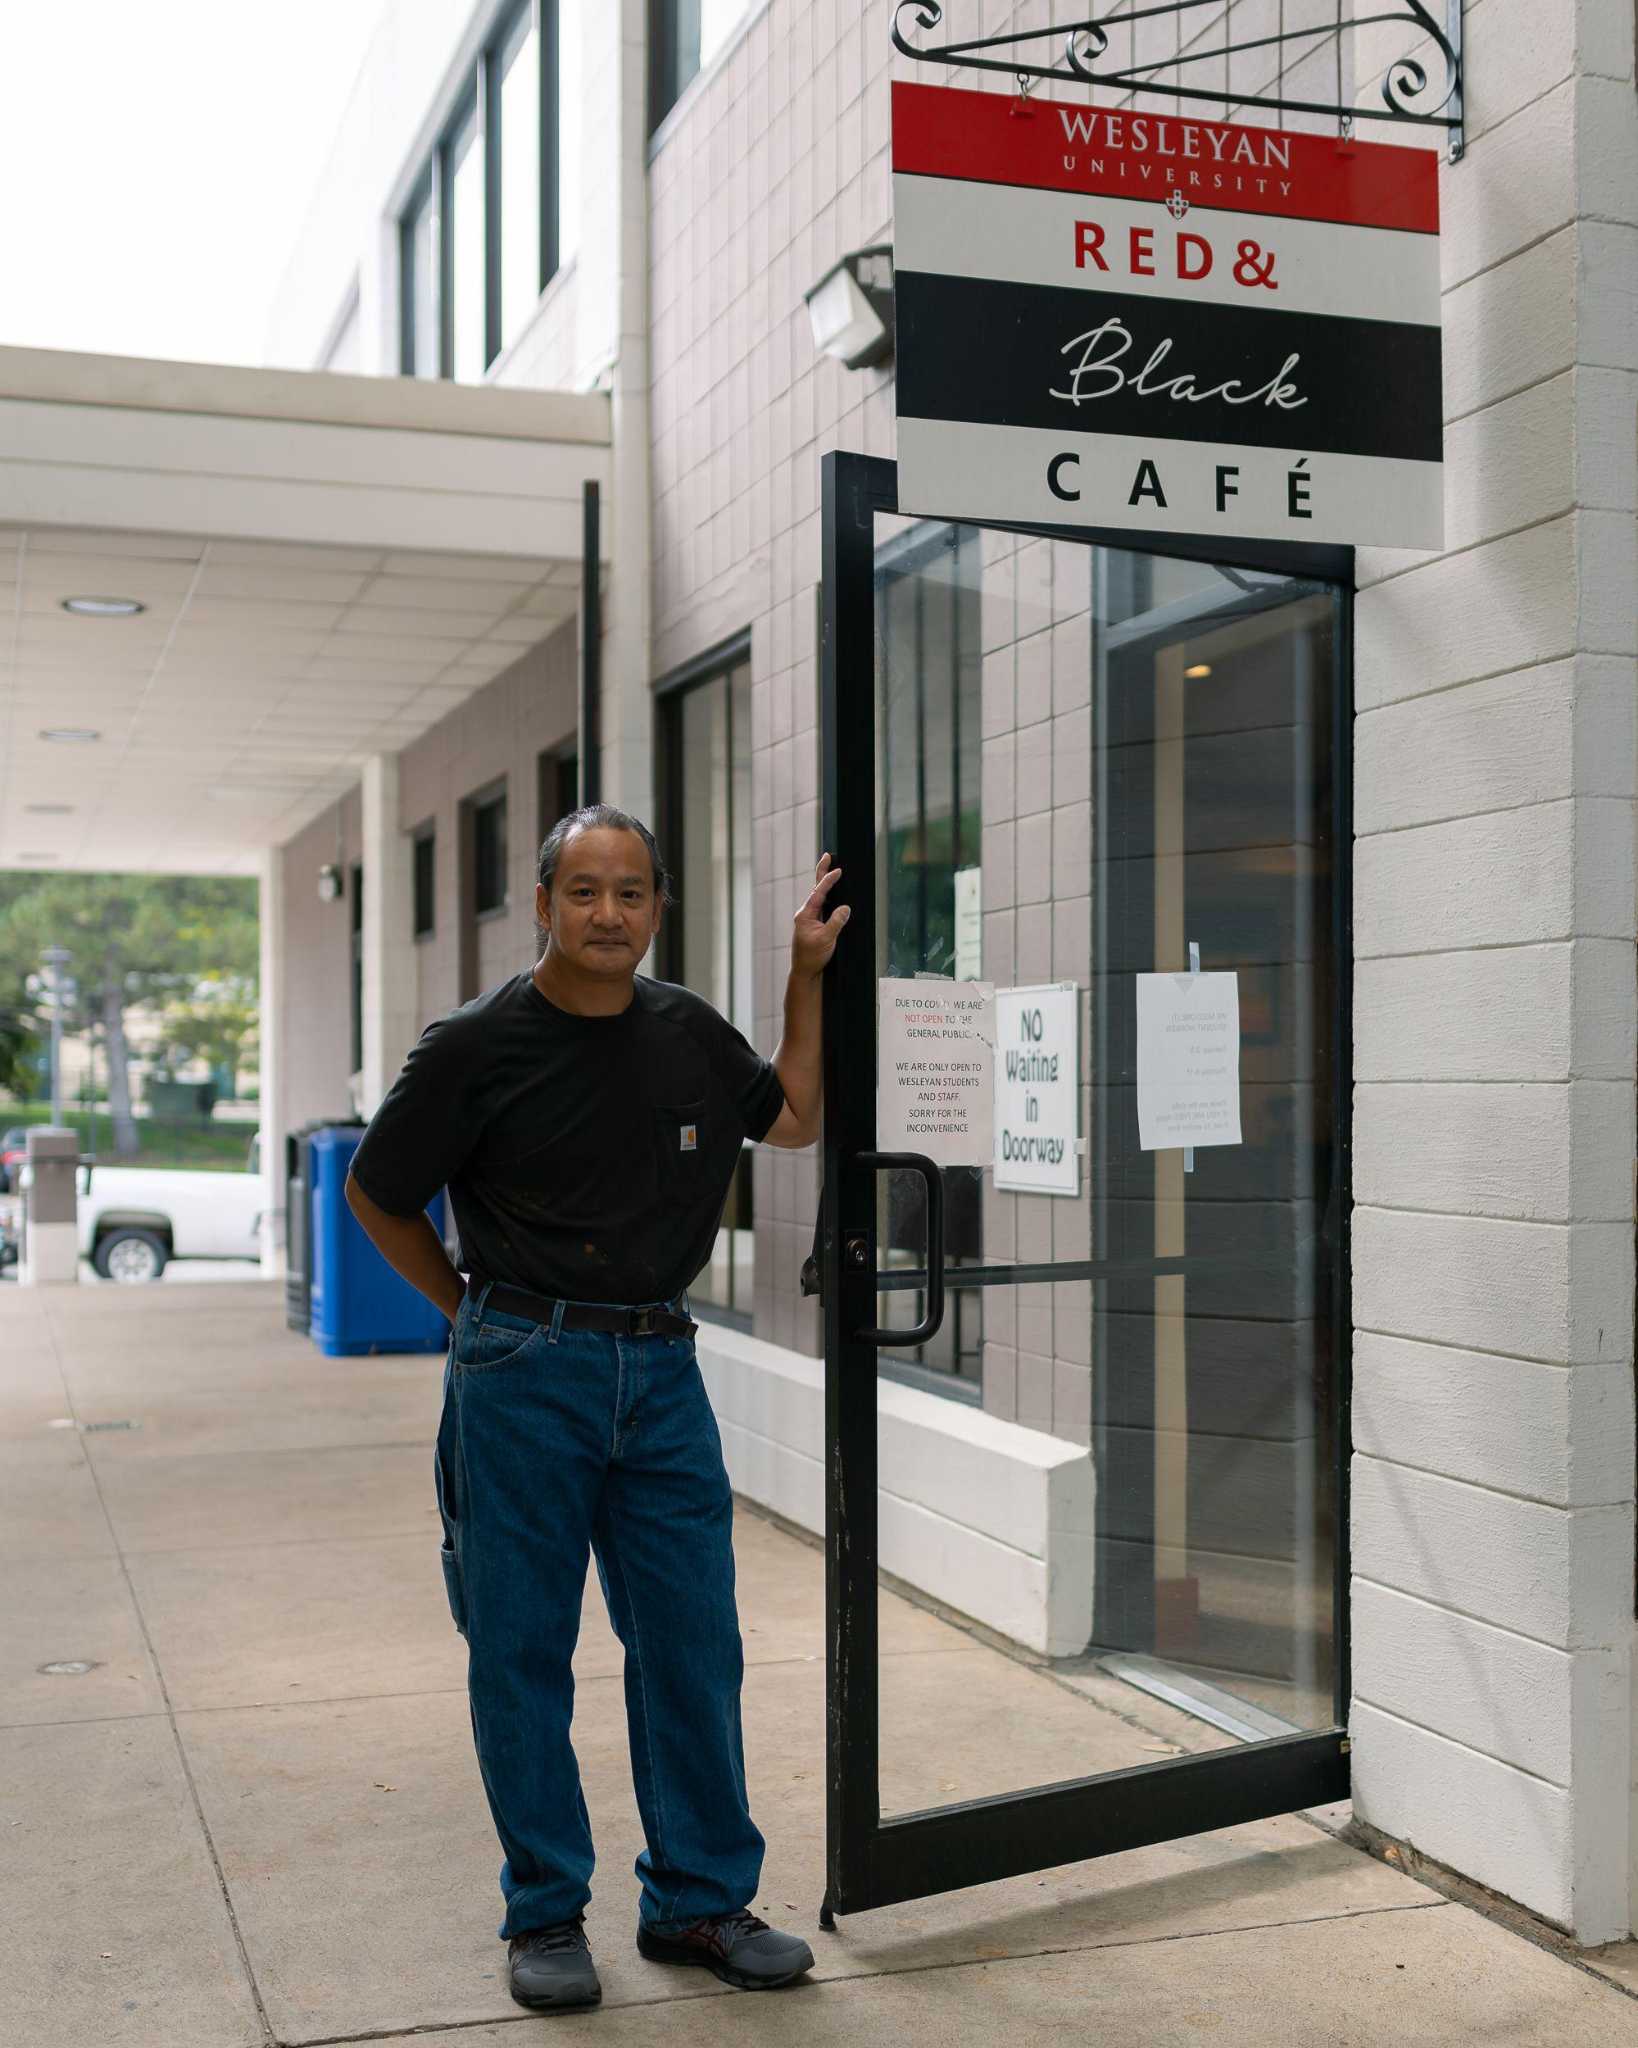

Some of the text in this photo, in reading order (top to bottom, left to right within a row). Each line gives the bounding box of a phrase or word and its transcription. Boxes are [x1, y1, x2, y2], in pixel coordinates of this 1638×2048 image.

[1057, 109, 1291, 169] WESLEYAN
[1063, 155, 1291, 196] UNIVERSITY
[1049, 317, 1309, 409] Black
[1046, 452, 1313, 519] CAFÉ
[895, 998, 910, 1008] DUE
[911, 999, 923, 1008] TO
[953, 1000, 965, 1010] WE
[967, 1000, 983, 1010] ARE
[904, 1014, 921, 1024] NOT
[922, 1014, 943, 1025] OPEN
[945, 1015, 957, 1025] TO
[1020, 1008, 1043, 1042] NO
[906, 1028, 941, 1039] GENERAL
[895, 1062, 982, 1072] WE ARE ONLY OPEN TO
[1005, 1048, 1059, 1083] Waiting
[897, 1077, 980, 1087] WESLEYAN STUDENTS
[918, 1092, 936, 1101] AND
[1025, 1089, 1039, 1123] in
[908, 1108, 968, 1118] SORRY FOR THE
[906, 1123, 969, 1133] INCONVENIENCE
[1002, 1129, 1065, 1164] Doorway
